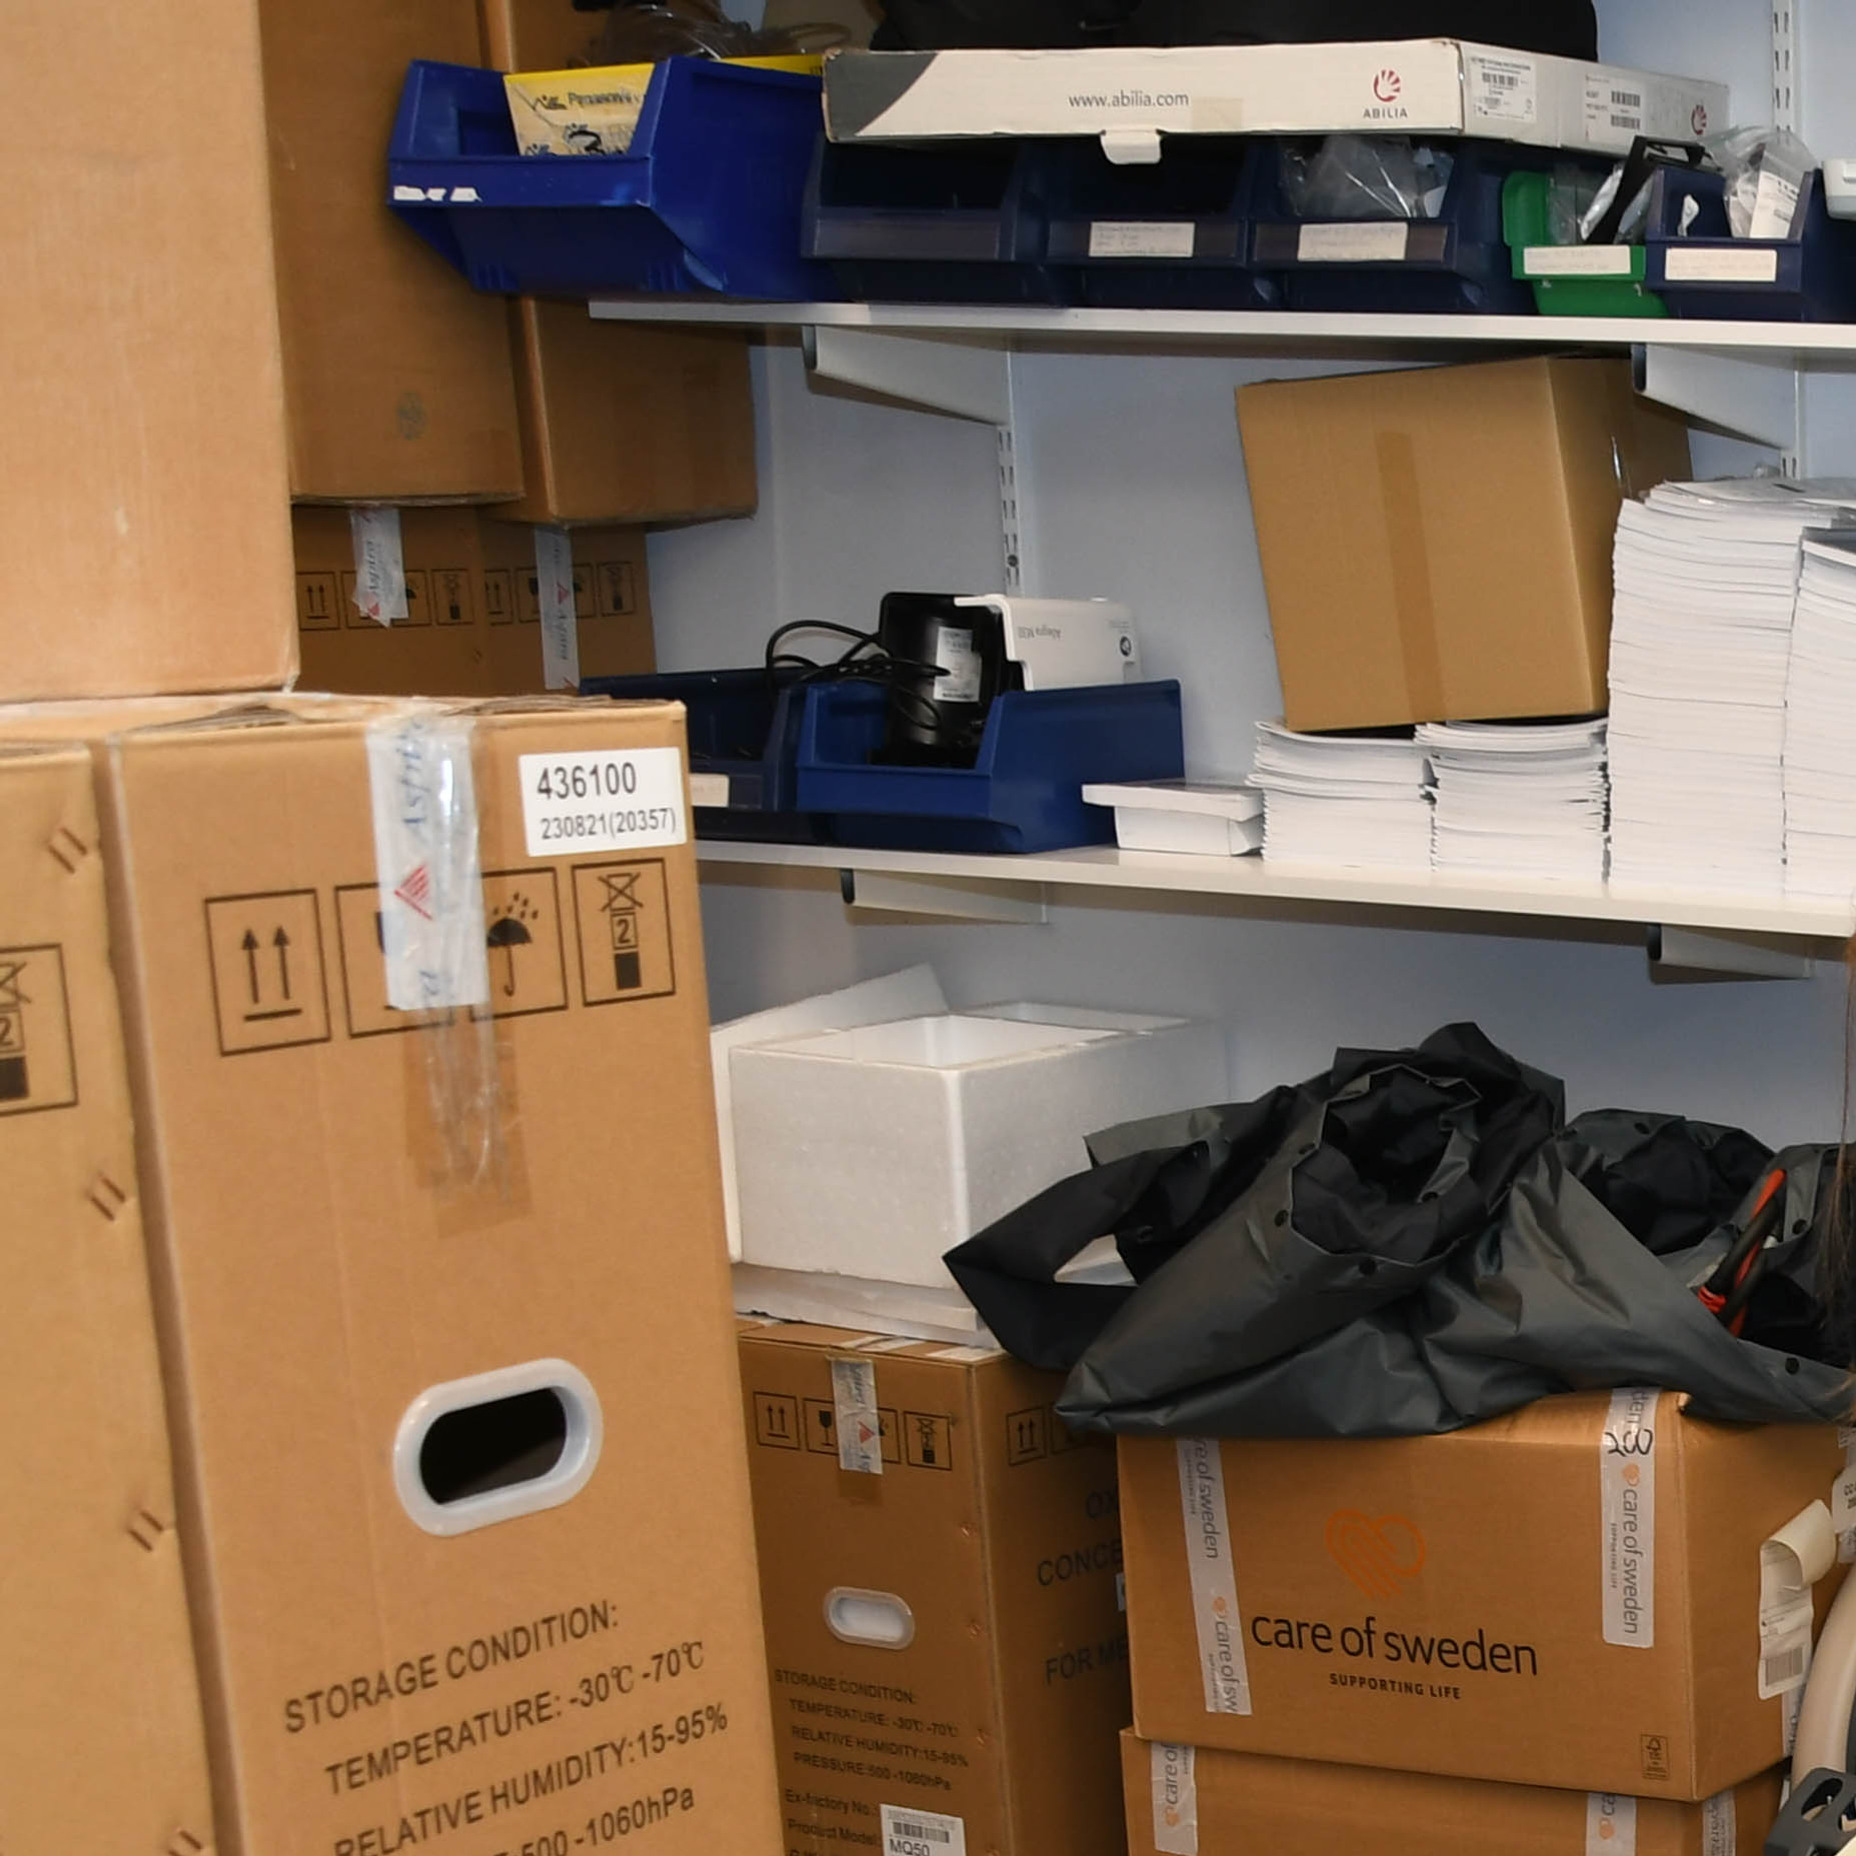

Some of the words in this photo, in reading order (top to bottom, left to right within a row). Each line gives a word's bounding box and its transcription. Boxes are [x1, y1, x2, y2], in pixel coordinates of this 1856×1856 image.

[1069, 90, 1189, 110] www.abilia.com
[1363, 107, 1408, 119] ABILIA
[537, 761, 637, 800] 436100
[540, 807, 677, 841] 230821(20357)
[1197, 1484, 1221, 1560] sweden
[1622, 1488, 1639, 1534] care
[1624, 1534, 1644, 1559] of
[1622, 1556, 1644, 1635] sweden
[1214, 1619, 1236, 1664] care
[1251, 1612, 1336, 1656] care
[1341, 1616, 1383, 1659] of
[1383, 1625, 1539, 1677] sweden
[284, 1654, 439, 1735] STORAGE
[445, 1599, 620, 1682] CONDITION:
[1045, 1649, 1094, 1687] FOR
[1220, 1664, 1240, 1686] of
[774, 1668, 837, 1693] STORAGE
[838, 1678, 915, 1705] CONDITION:
[1329, 1672, 1424, 1700] SUPPORTING
[1429, 1682, 1462, 1701] LIFE
[789, 1698, 890, 1728] TEMPERATURE:
[325, 1690, 564, 1796] TEMPERATURE:
[791, 1725, 854, 1750] RELATIVE
[785, 1789, 850, 1815] Ex-factory
[1161, 1764, 1181, 1805] care
[574, 1784, 696, 1848] -1060hPa
[787, 1818, 839, 1842] Product
